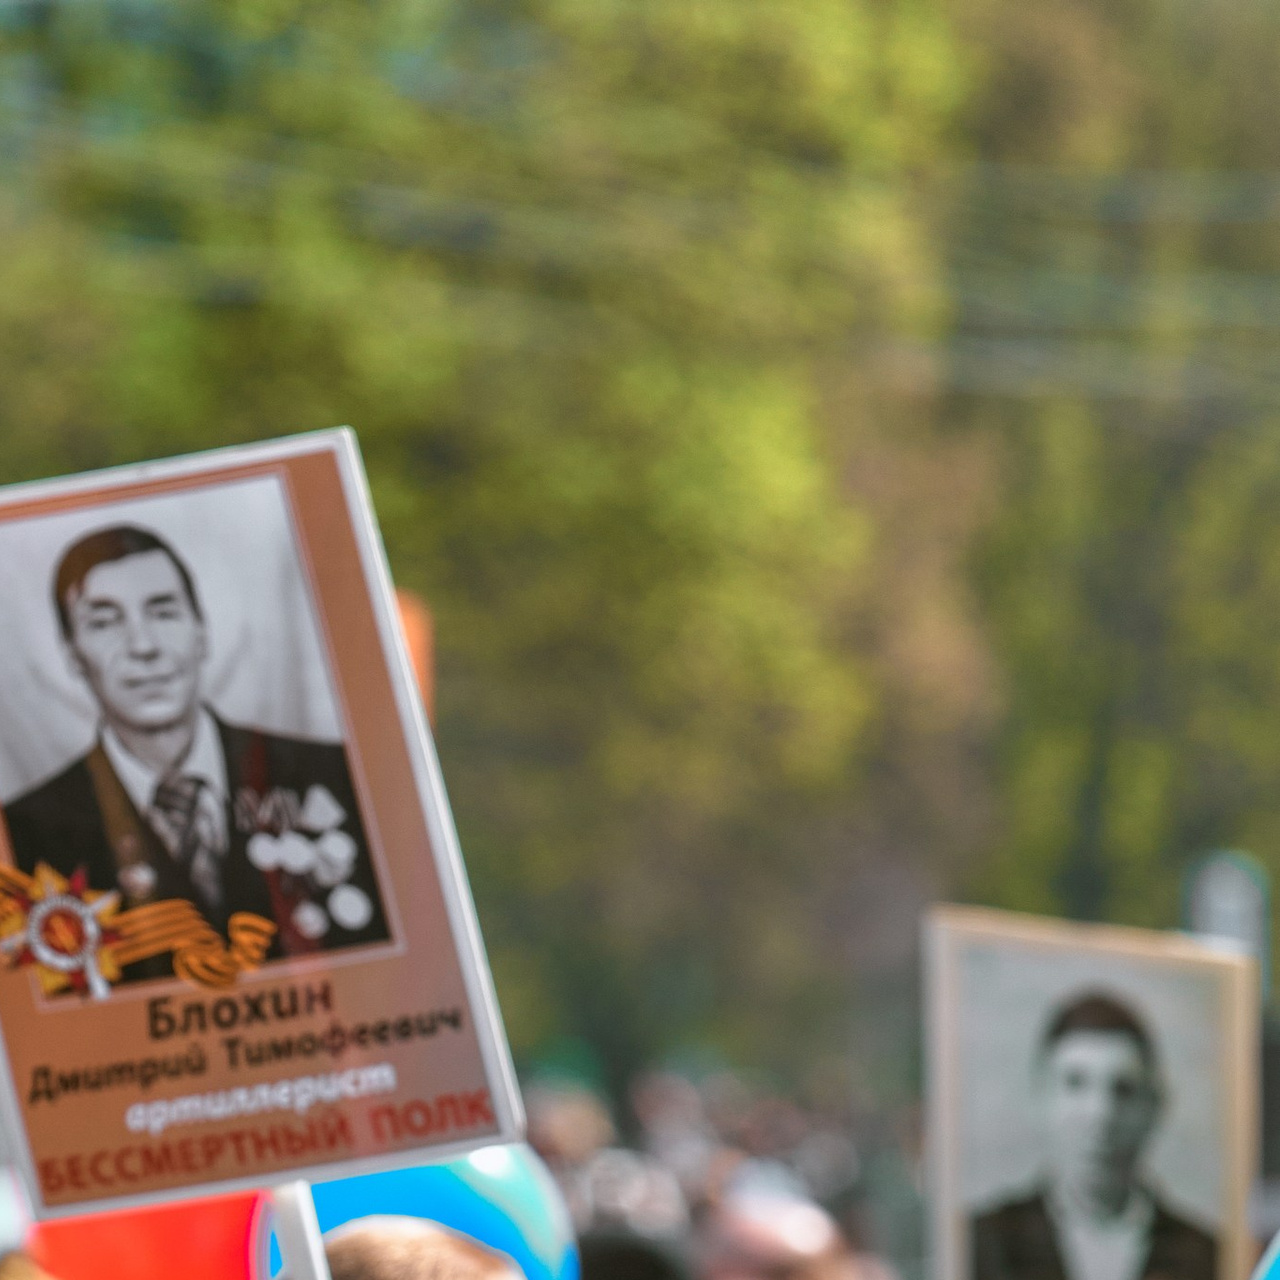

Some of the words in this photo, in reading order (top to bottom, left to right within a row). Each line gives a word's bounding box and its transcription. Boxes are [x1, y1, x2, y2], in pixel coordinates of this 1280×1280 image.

[147, 980, 331, 1040] Блохин
[28, 1042, 208, 1105] Дмитрий
[224, 1008, 461, 1069] Тимофеевич
[125, 1061, 397, 1138] артиллерист
[39, 1108, 354, 1193] БЕССМЕРТНЫЙ
[369, 1088, 496, 1146] ПОЛК
